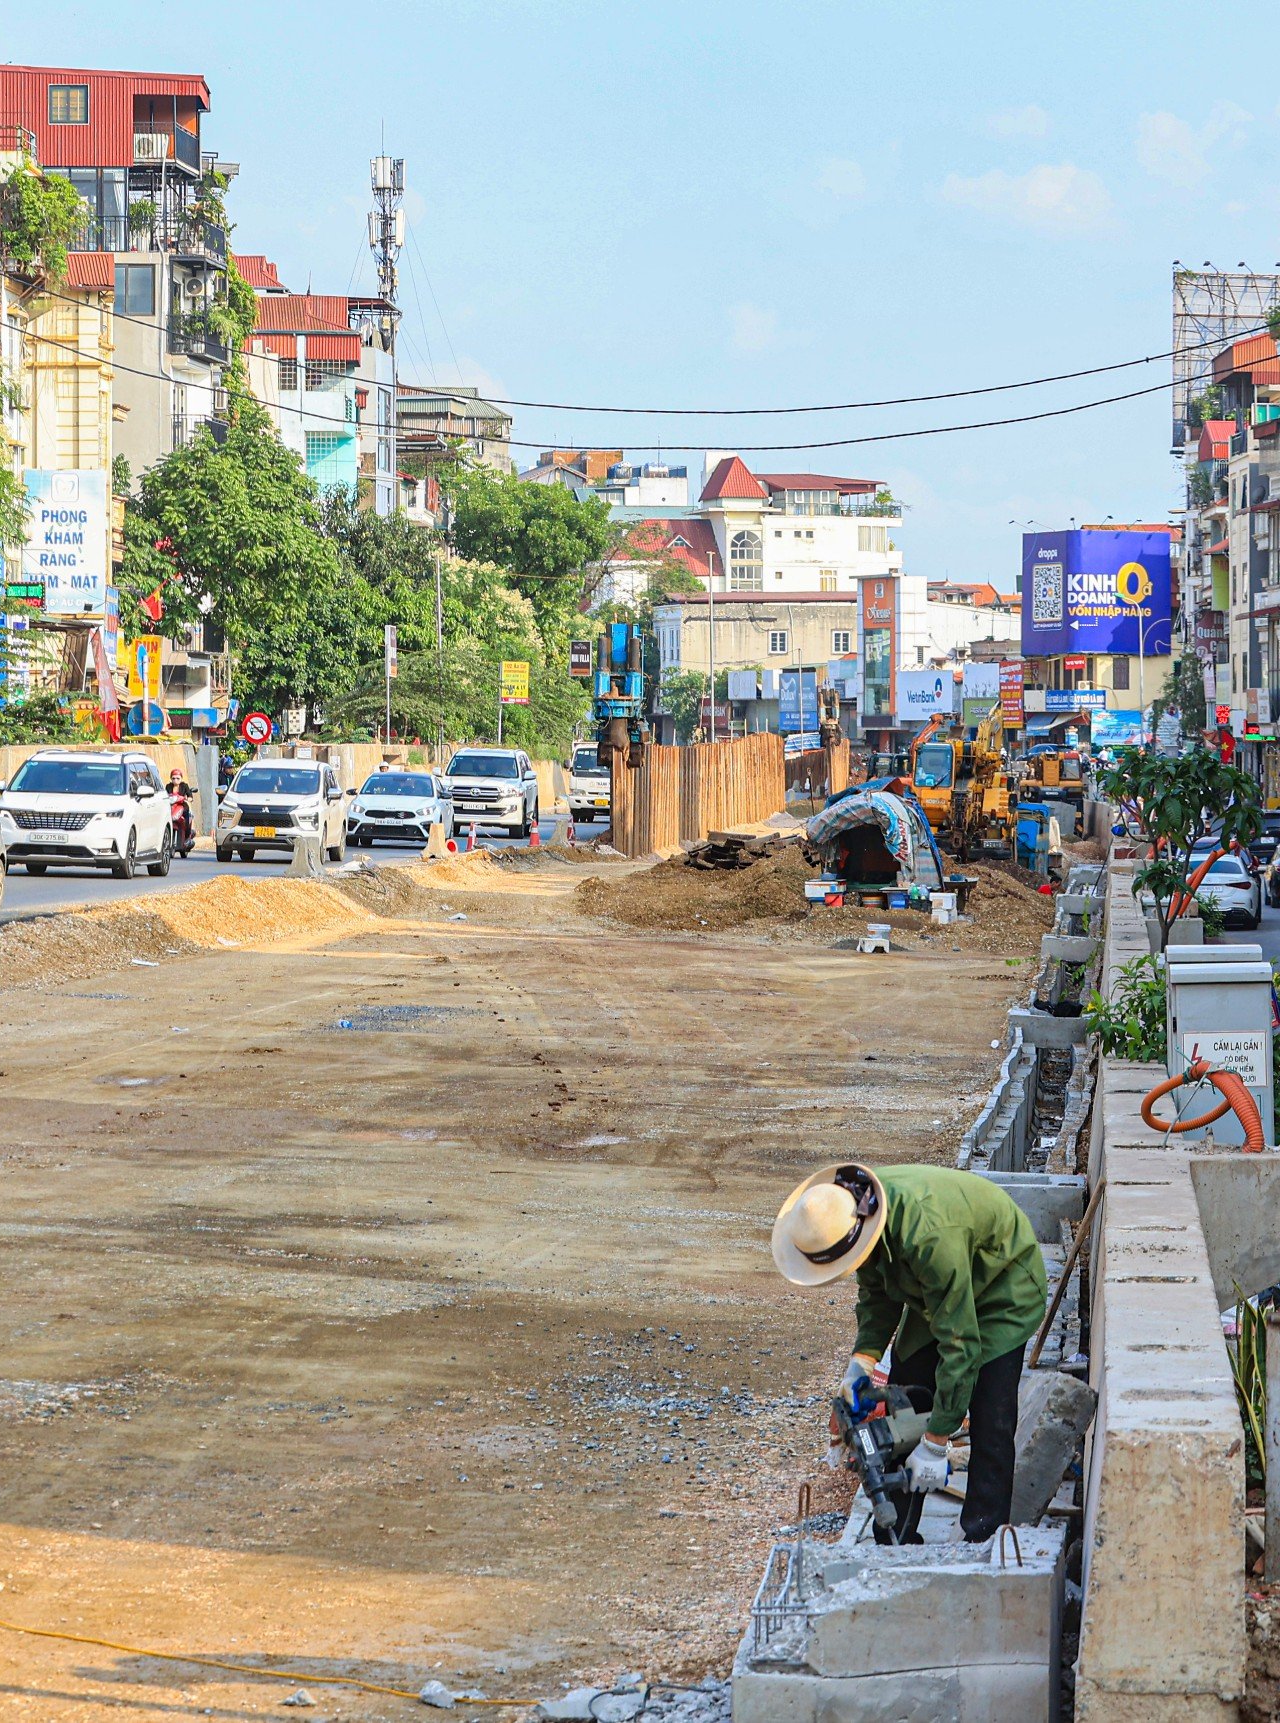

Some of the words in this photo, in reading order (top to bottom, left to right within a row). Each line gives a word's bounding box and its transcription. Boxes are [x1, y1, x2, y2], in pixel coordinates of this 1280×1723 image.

[41, 507, 88, 523] PHÒNG
[1067, 574, 1117, 592] KINH
[1067, 592, 1117, 604] DOANH
[1093, 605, 1121, 619] NHẬP
[1122, 605, 1152, 617] HÀNG
[907, 690, 936, 704] VietinBank
